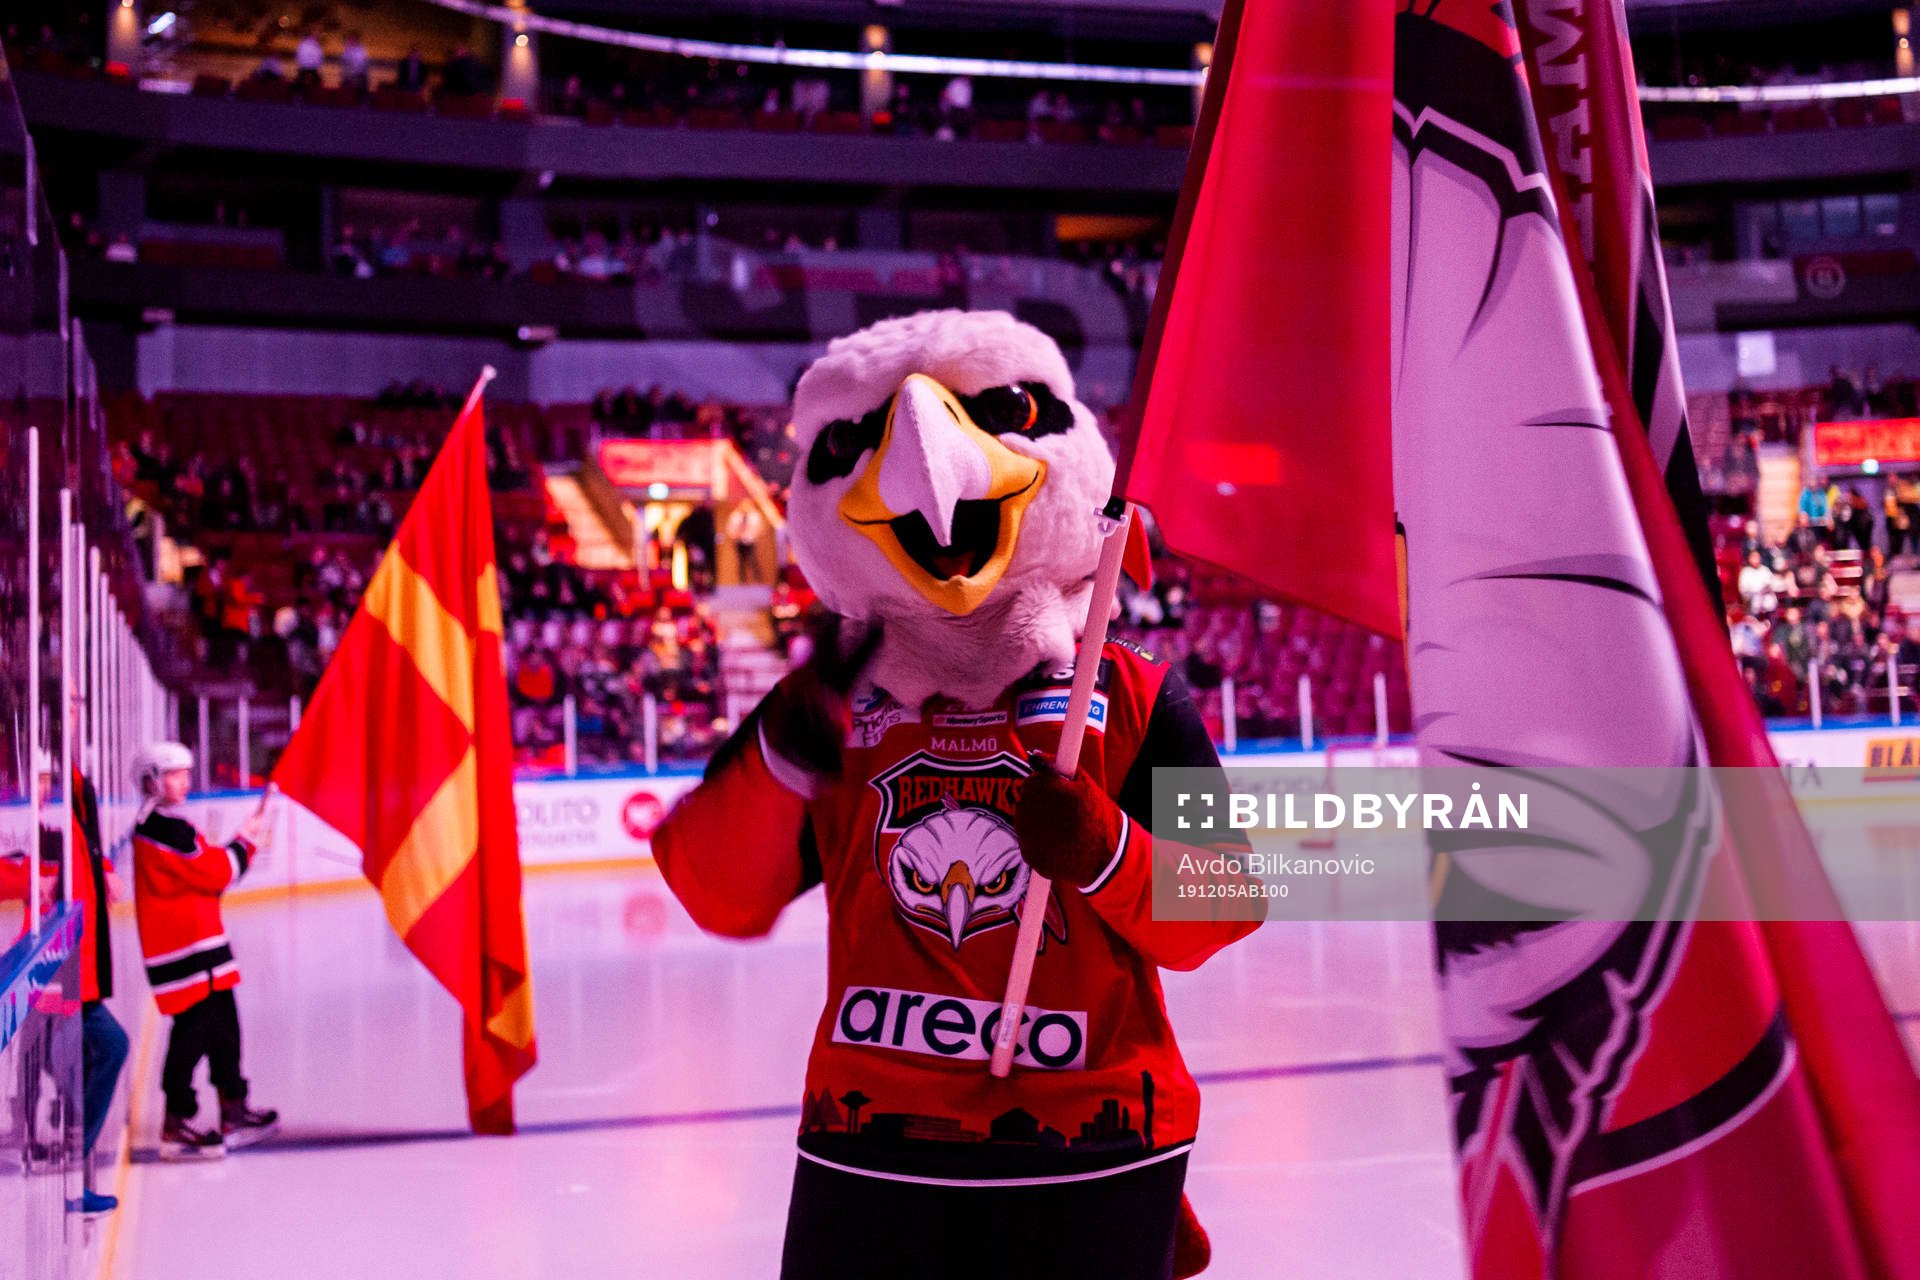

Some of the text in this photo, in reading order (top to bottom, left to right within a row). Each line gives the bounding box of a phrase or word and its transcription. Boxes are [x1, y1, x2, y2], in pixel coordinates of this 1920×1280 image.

[1024, 700, 1101, 716] EHRENG
[897, 776, 1025, 820] REDHAWKS
[841, 988, 1083, 1068] areco
